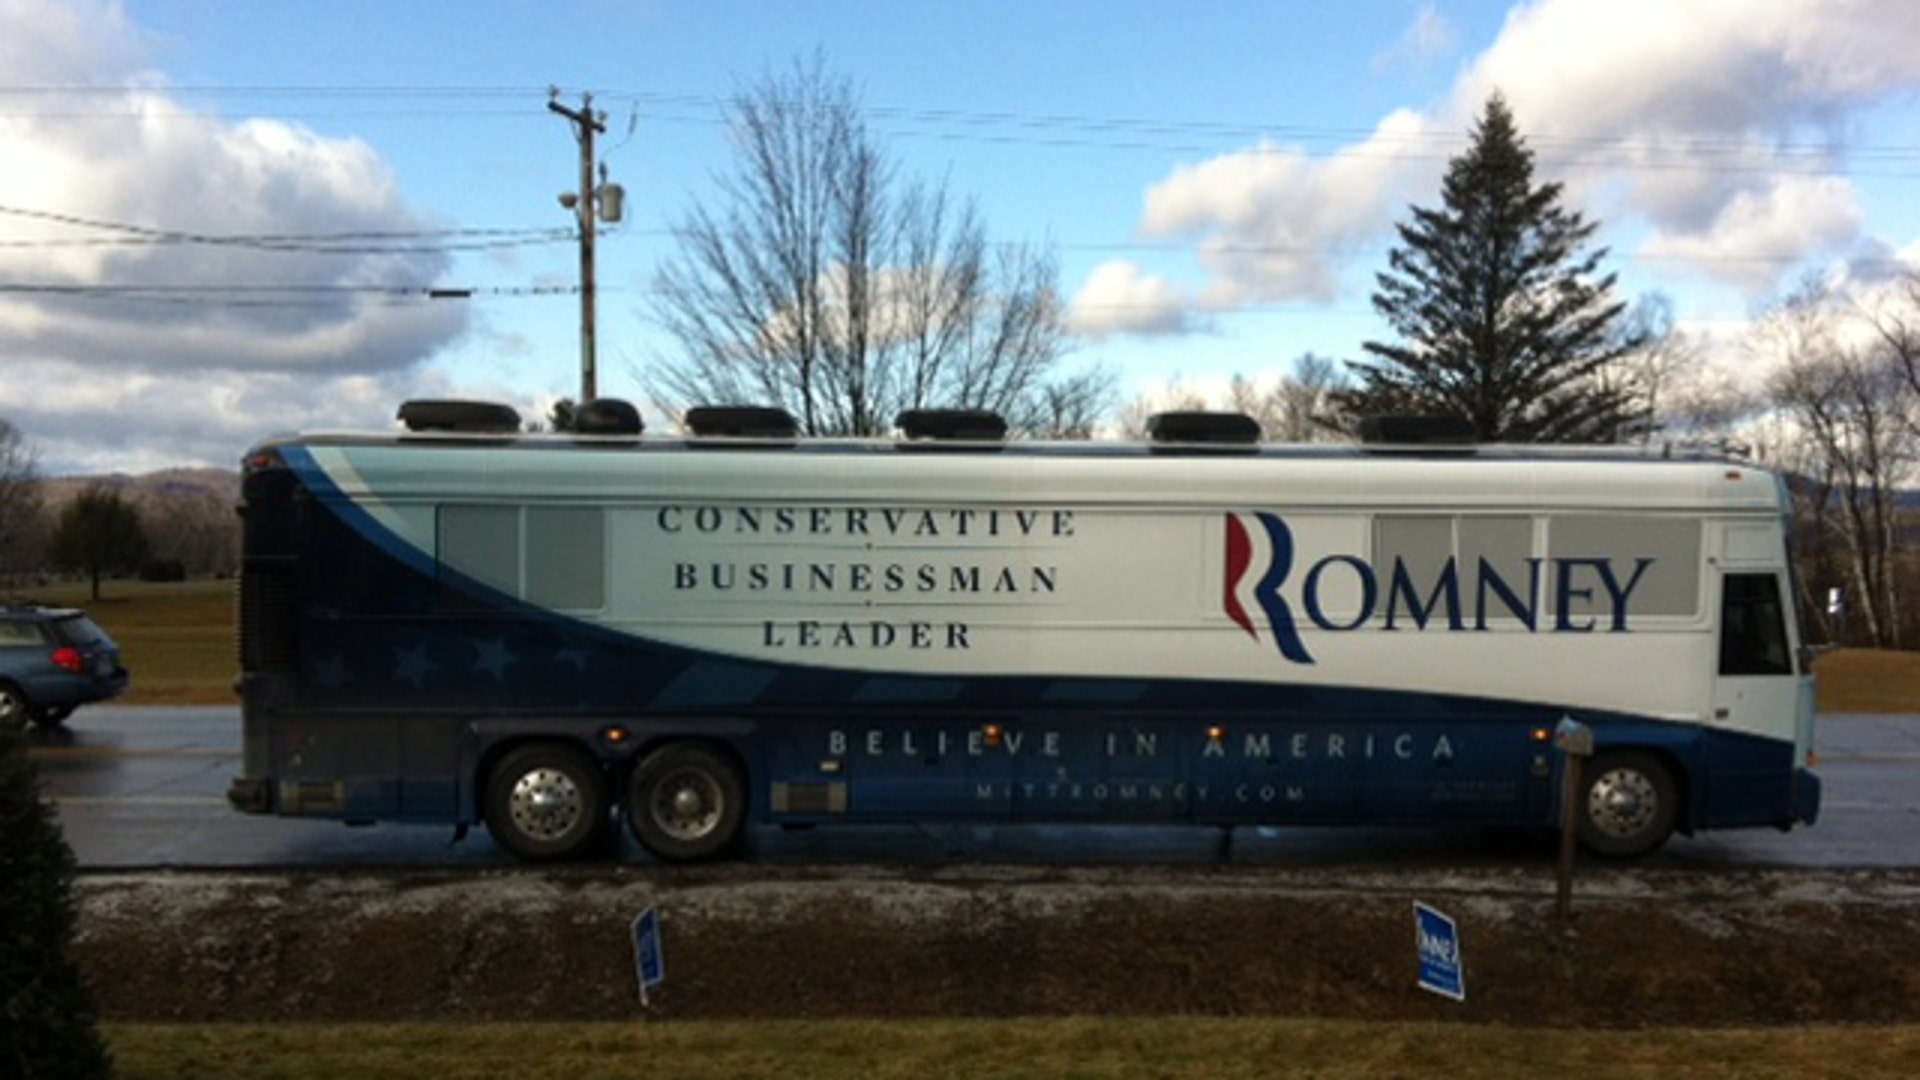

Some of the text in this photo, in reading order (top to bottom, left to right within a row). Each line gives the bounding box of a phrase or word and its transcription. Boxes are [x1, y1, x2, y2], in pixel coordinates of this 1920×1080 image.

[656, 505, 1076, 536] CONSERVATIVE
[673, 563, 1058, 593] BUSINESSMAN
[1222, 510, 1657, 665] ROMNEY
[762, 620, 971, 649] LEADER
[829, 729, 1454, 759] BELIEVE IN AMERICA
[976, 782, 1305, 801] MITTROMNEY.COM
